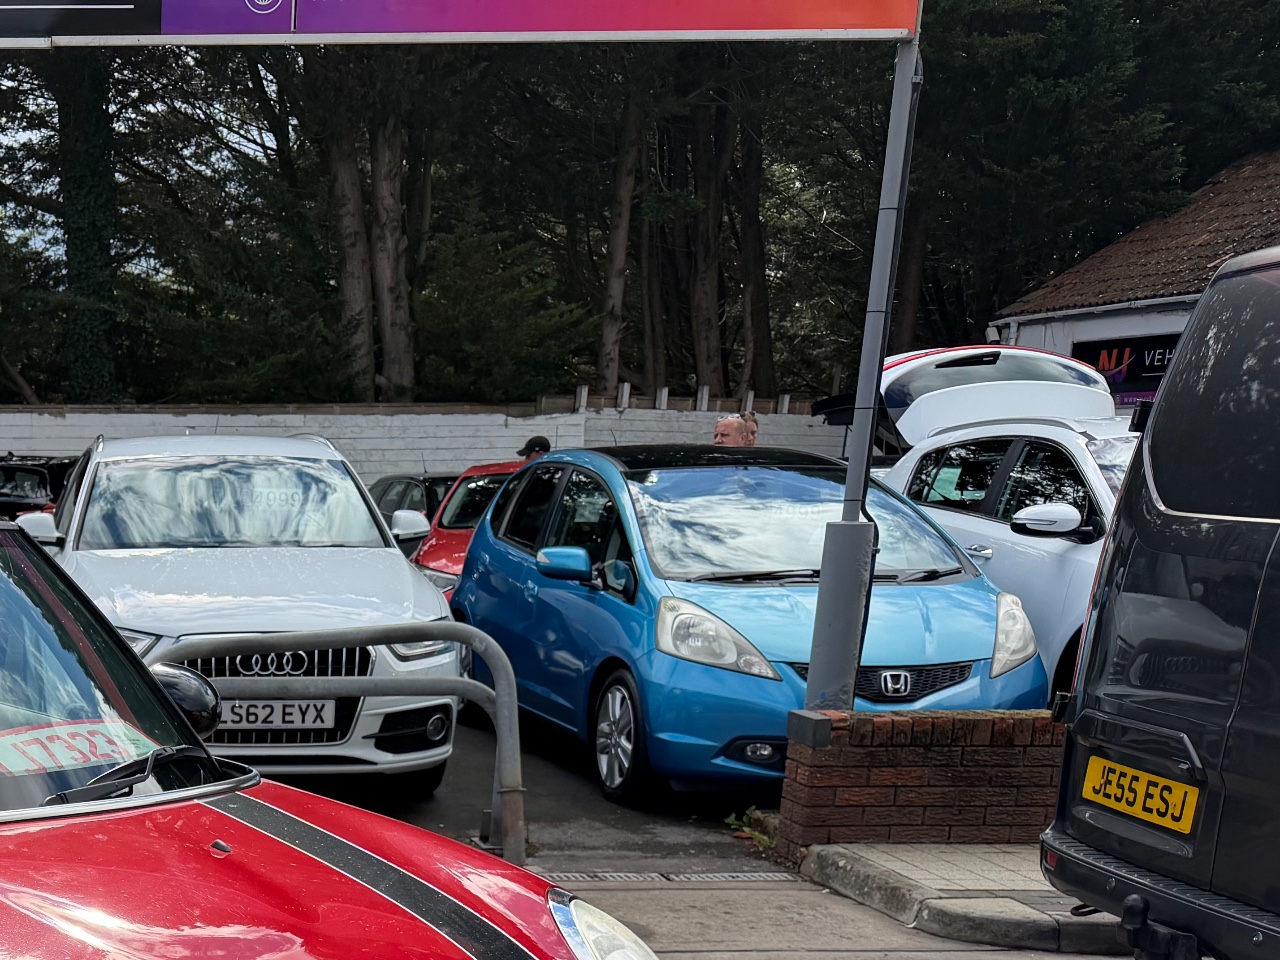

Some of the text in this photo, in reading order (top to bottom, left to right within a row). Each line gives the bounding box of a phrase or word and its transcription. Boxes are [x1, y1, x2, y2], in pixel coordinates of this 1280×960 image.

[1099, 348, 1131, 382] NJ
[220, 703, 326, 724] S62 EYX
[1092, 765, 1188, 822] JE55 ESJ
